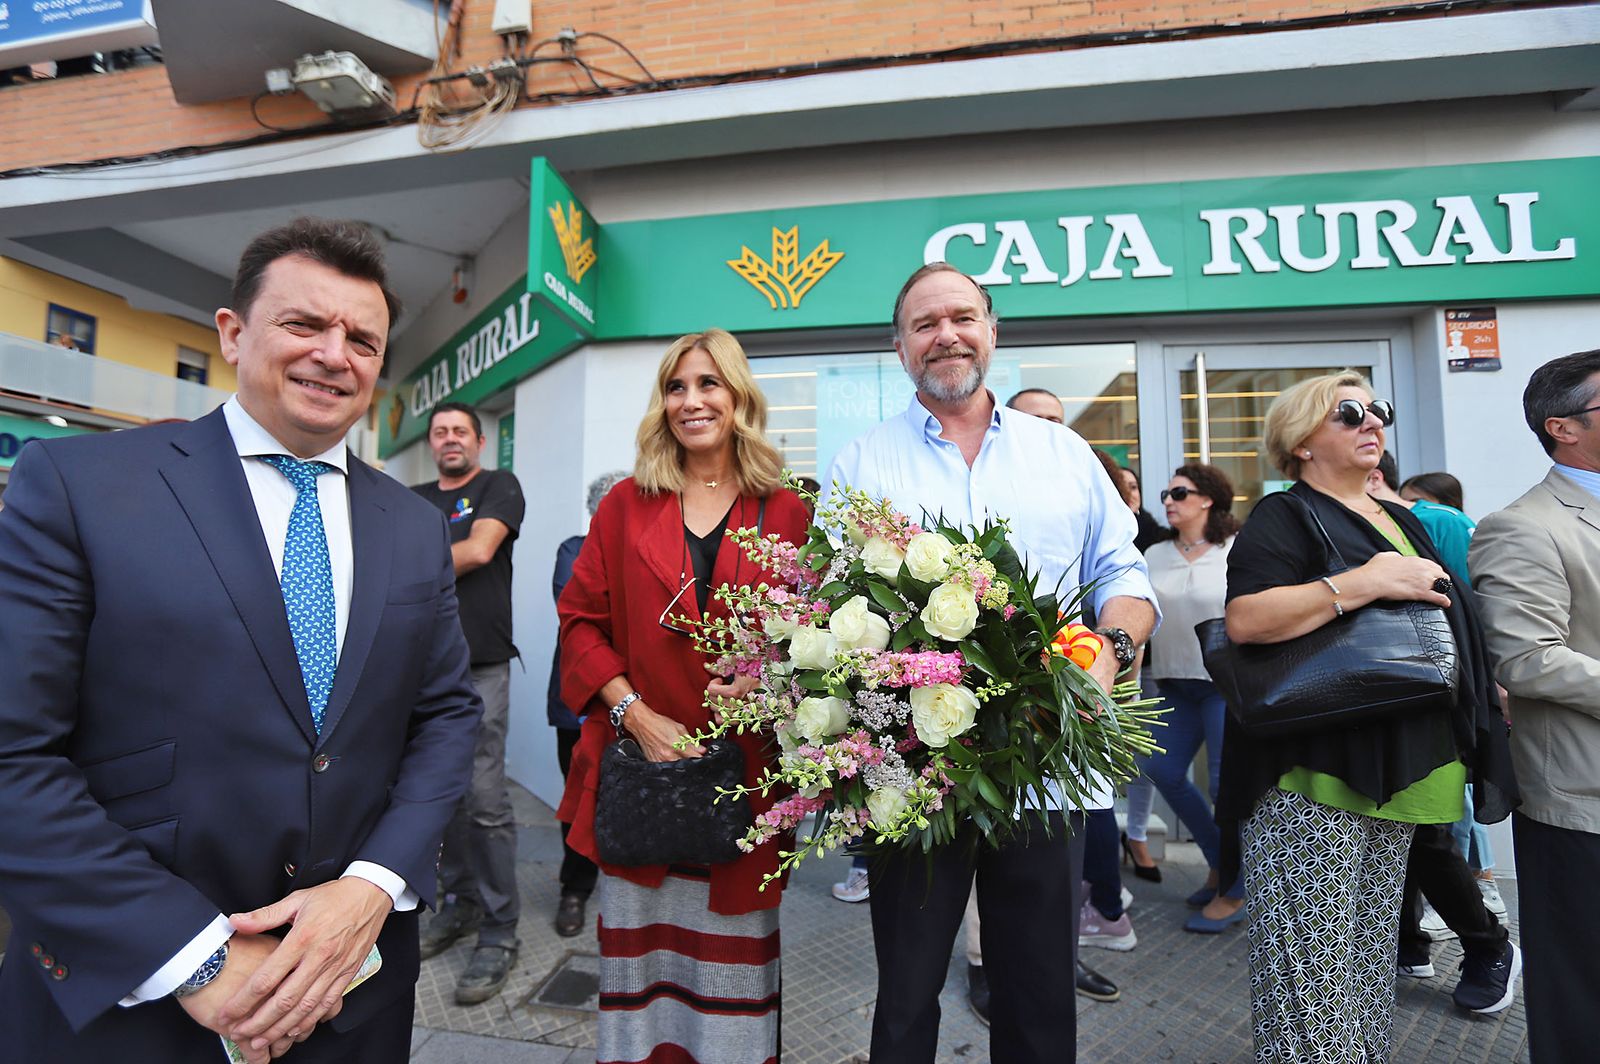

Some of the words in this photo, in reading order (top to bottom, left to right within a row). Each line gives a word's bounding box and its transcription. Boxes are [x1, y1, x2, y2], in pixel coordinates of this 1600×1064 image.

[923, 213, 1174, 288] CAJA
[1200, 191, 1576, 276] RURAL
[543, 271, 567, 301] CAJA
[568, 290, 595, 324] RURAL
[411, 358, 452, 417] CAJA
[455, 292, 539, 389] RURAL
